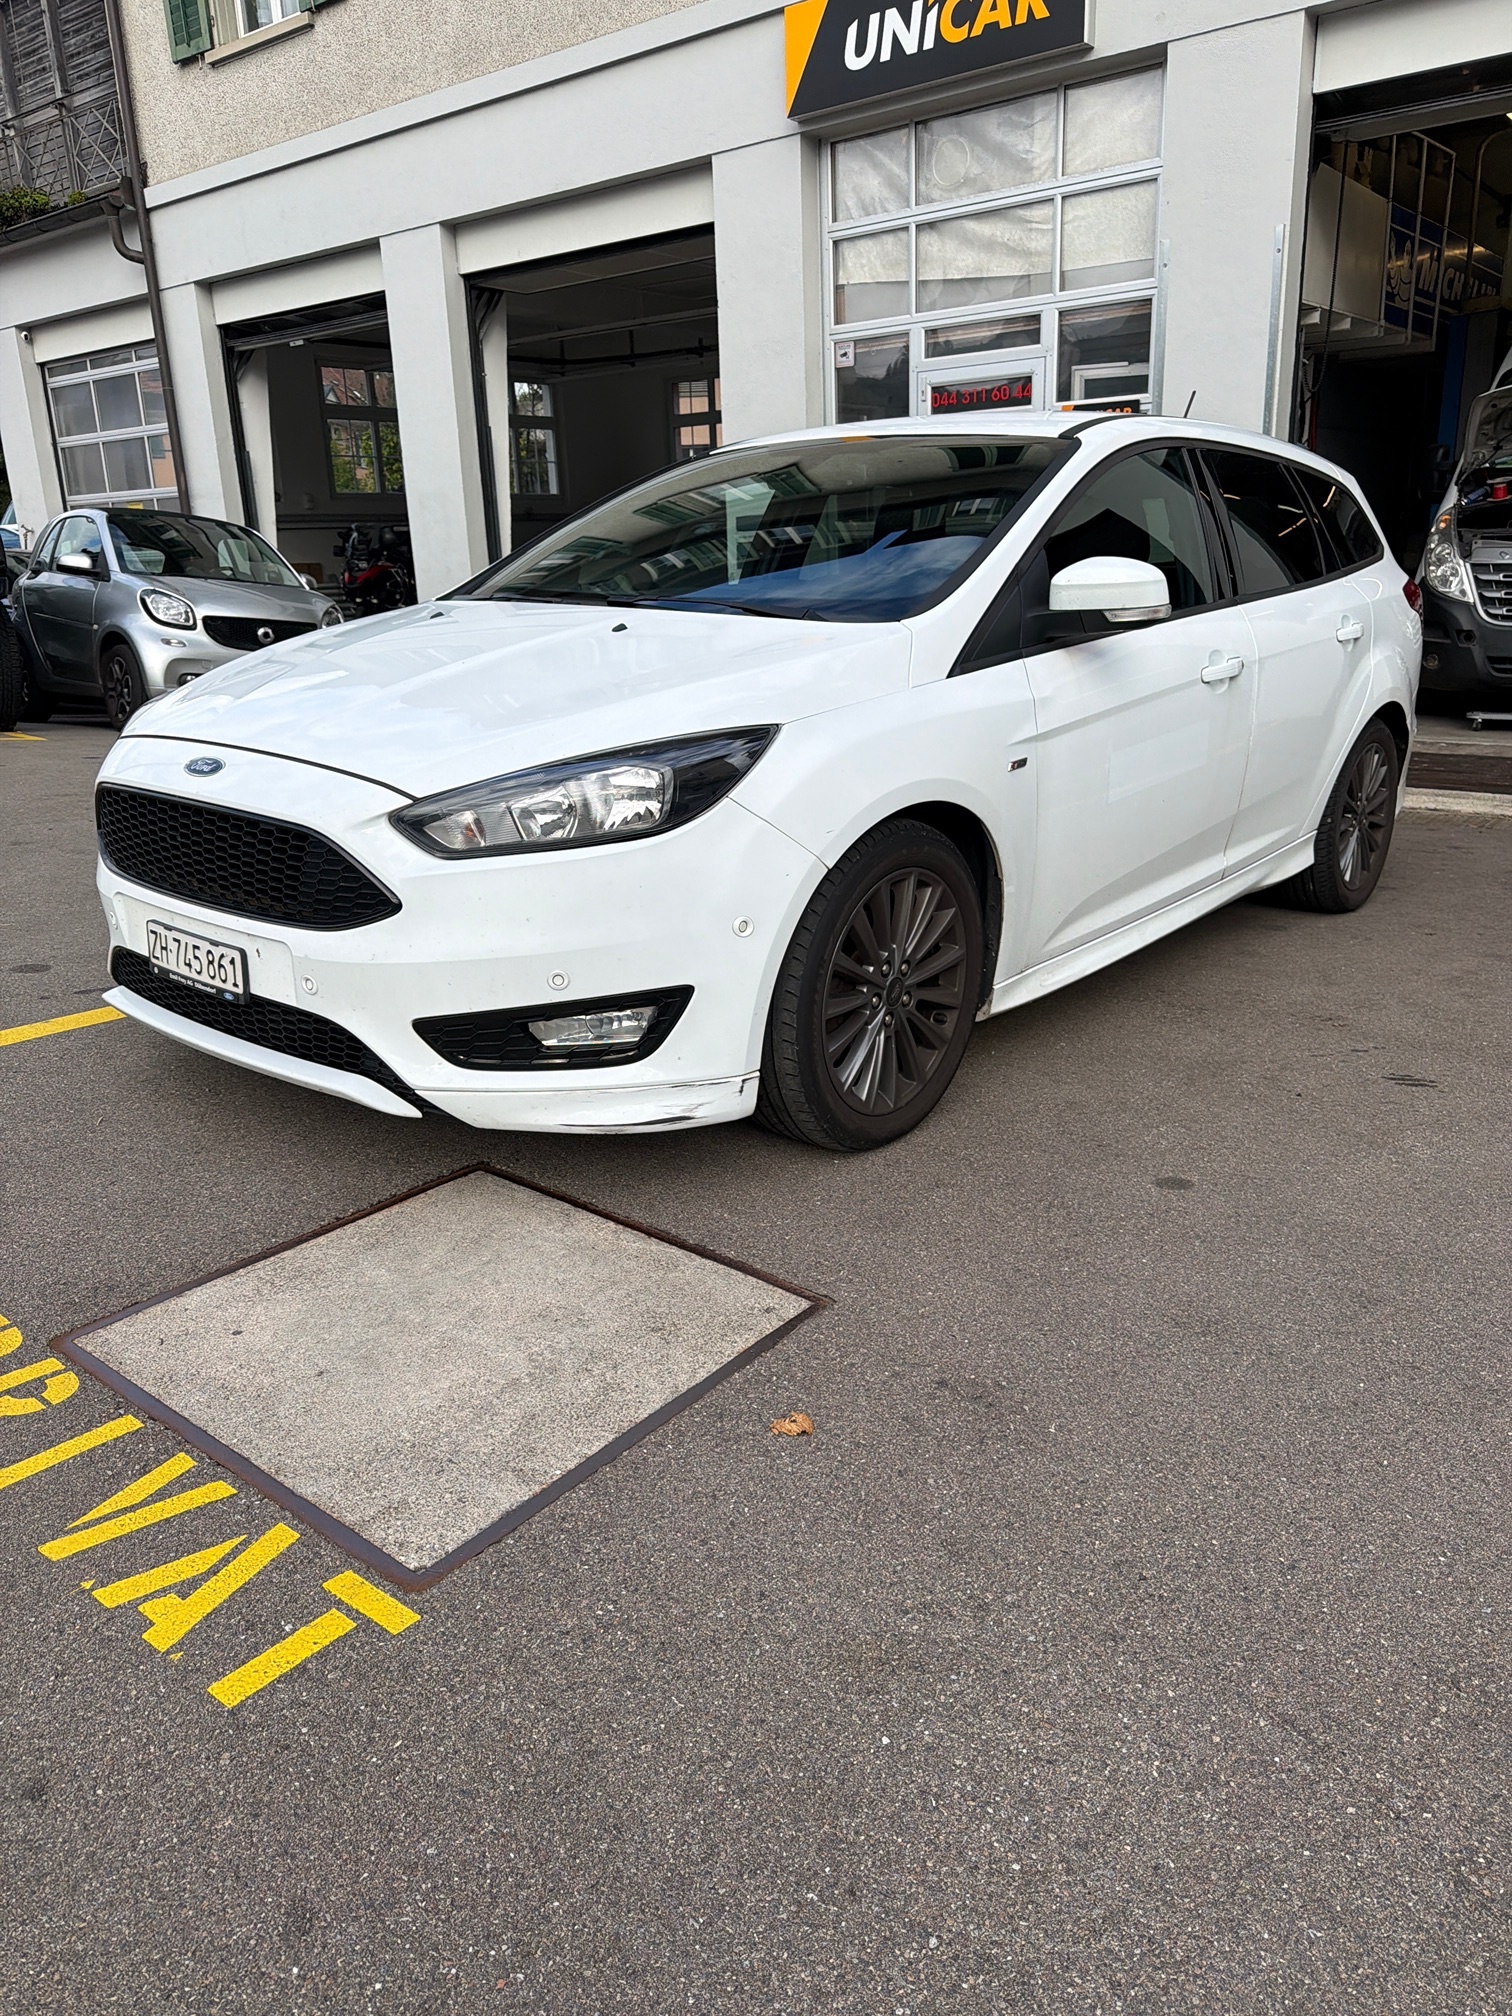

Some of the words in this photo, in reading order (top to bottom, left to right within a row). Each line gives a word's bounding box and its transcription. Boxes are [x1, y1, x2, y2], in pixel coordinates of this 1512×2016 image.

[932, 391, 958, 408] 044
[962, 387, 986, 404] 311
[991, 384, 1010, 401] 60
[1013, 383, 1032, 399] 44
[0, 1313, 422, 1710] IVAT
